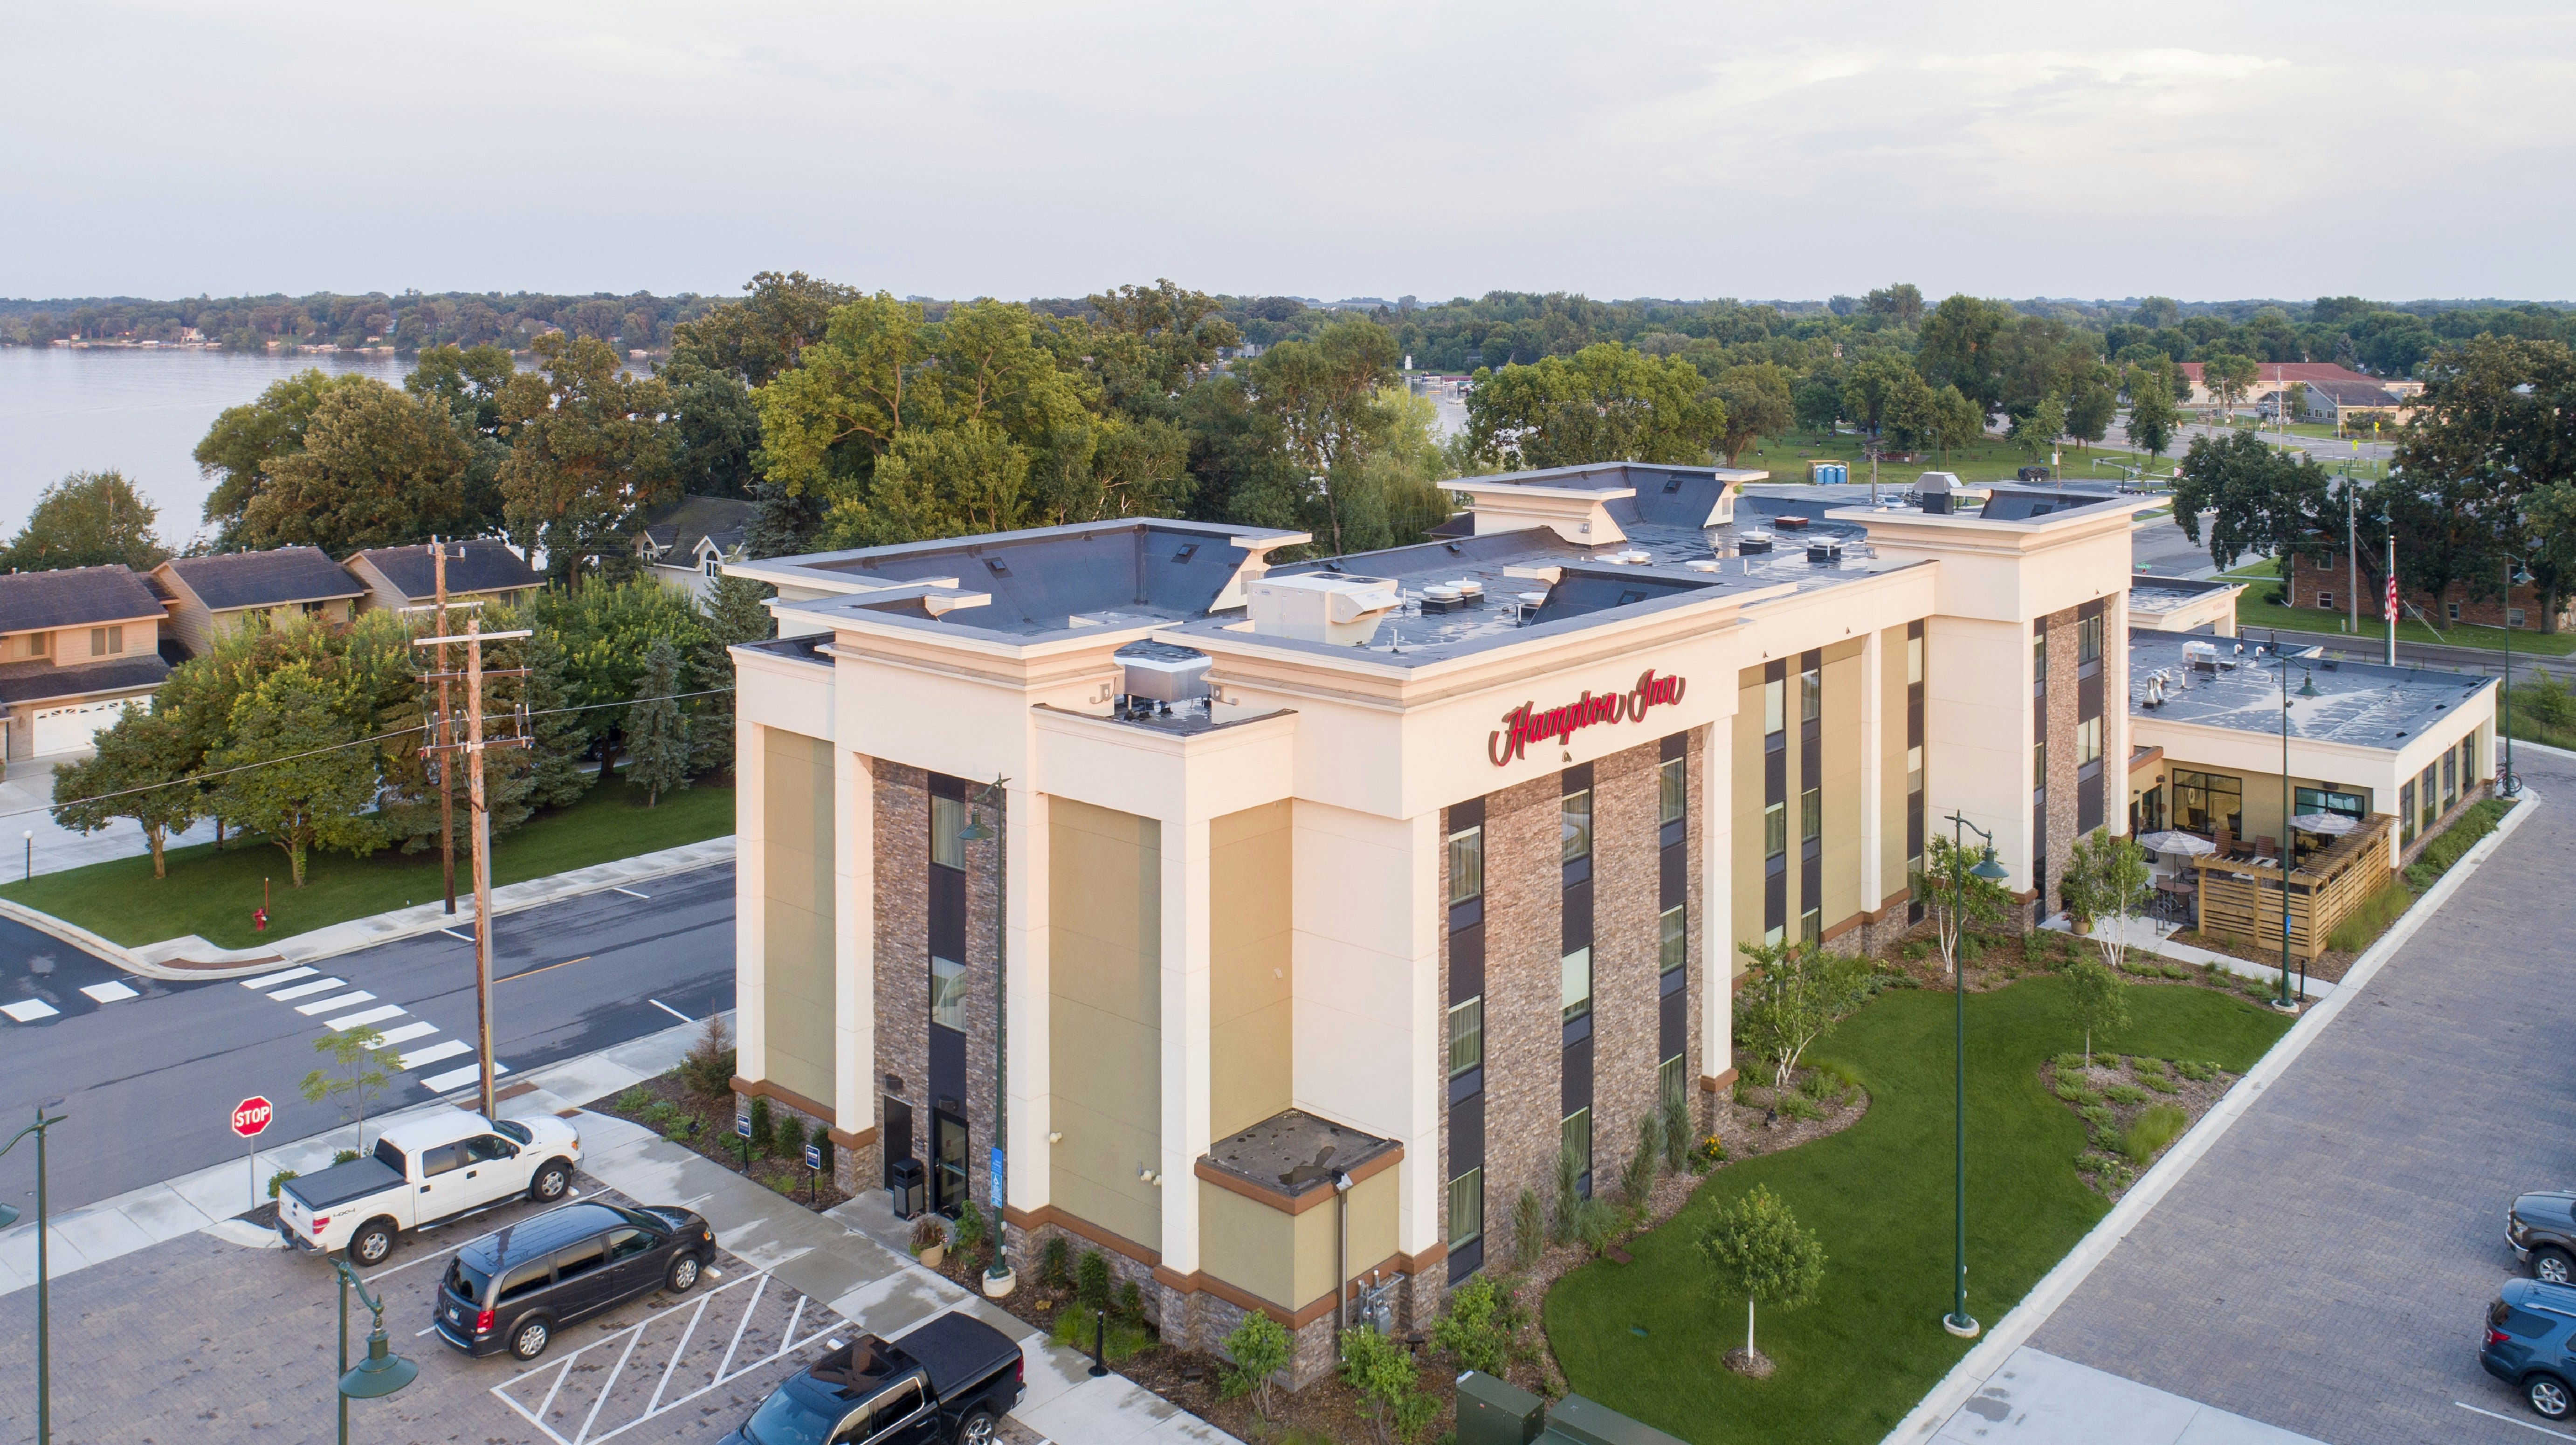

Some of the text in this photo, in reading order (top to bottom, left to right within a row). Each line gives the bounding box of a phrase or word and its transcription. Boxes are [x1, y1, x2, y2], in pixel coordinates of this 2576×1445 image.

[1488, 668, 1686, 767] Hampton Inn
[235, 1106, 270, 1127] STOP
